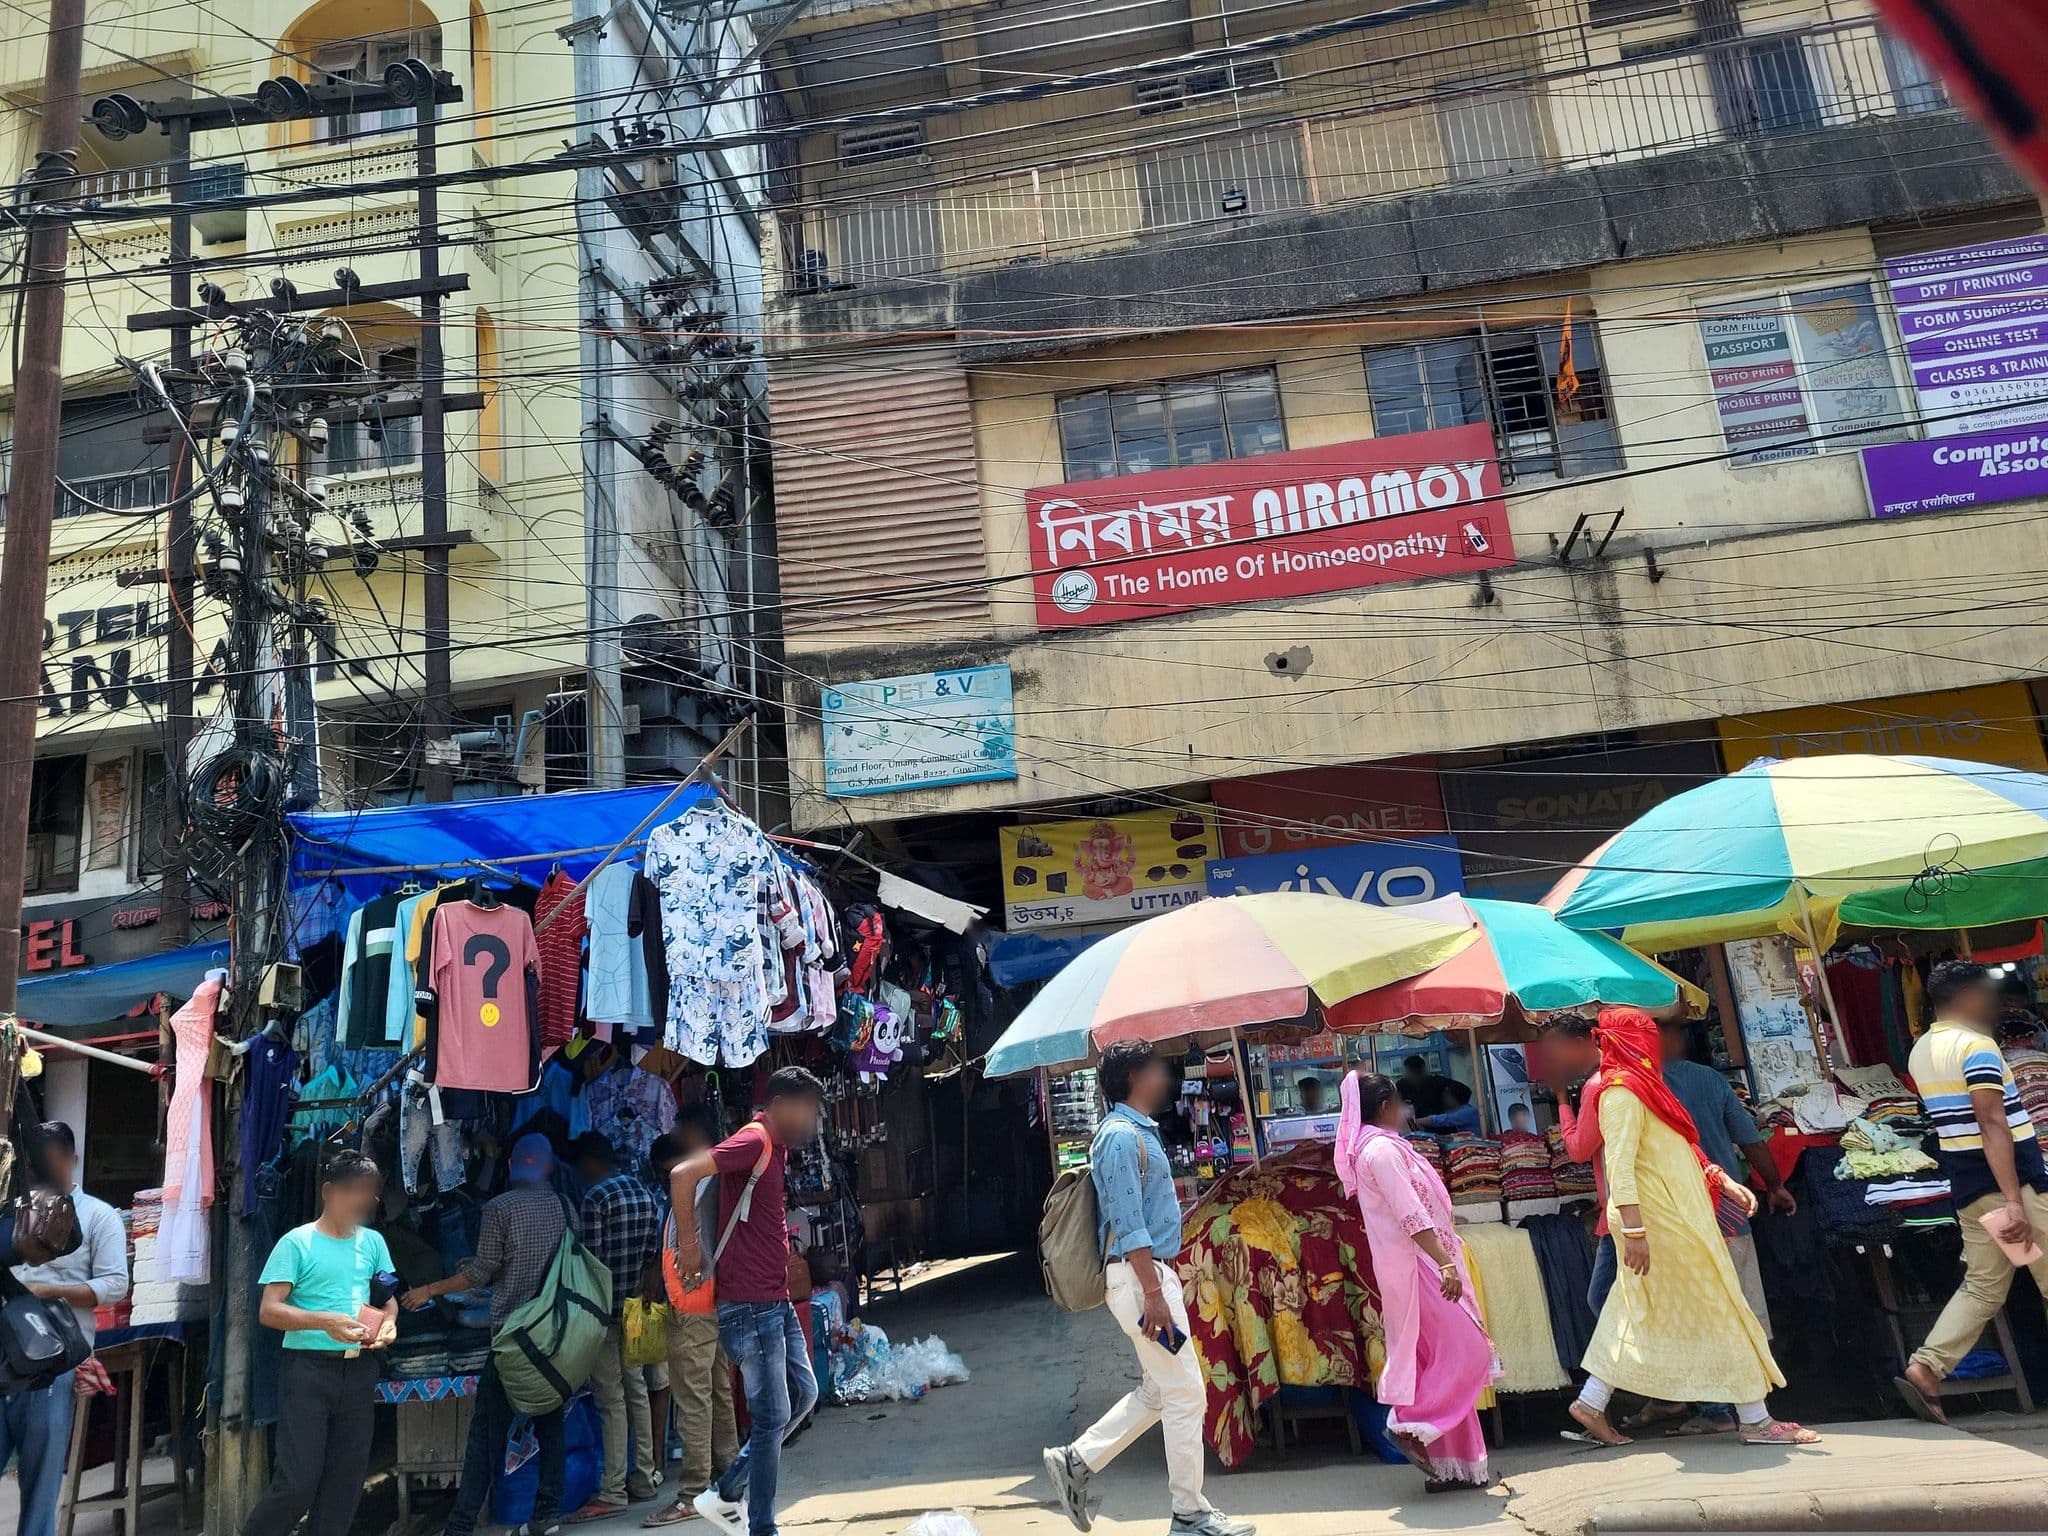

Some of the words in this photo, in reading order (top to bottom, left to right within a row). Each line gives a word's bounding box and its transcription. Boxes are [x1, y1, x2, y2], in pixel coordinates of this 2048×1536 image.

[1919, 284, 1948, 298] DTP
[1962, 271, 2033, 292] PRINTING
[1914, 311, 1960, 328] FORM
[1963, 297, 2048, 321] SUBMISSIO
[1707, 324, 1737, 333] FORM
[1742, 321, 1775, 331] FILLUP
[1712, 337, 1776, 356] PASSPORT
[1944, 333, 2001, 352] ONLINE
[2004, 328, 2039, 342] TEST
[1717, 371, 1748, 383] PHTO
[1752, 366, 1785, 381] PRINT
[1929, 365, 1986, 384] CLASSES
[1989, 363, 2000, 375] &
[1719, 396, 1761, 411] MOBILE
[1764, 391, 1798, 404] PRINT
[1728, 419, 1800, 438] SCANNING
[1252, 459, 1487, 537] NIRAMOY
[1103, 573, 1150, 598] The
[1157, 564, 1229, 591] Home
[1235, 552, 1265, 580] Of
[1271, 531, 1448, 575] Homoeopathy
[935, 678, 951, 697] &
[827, 763, 858, 776] Ground
[1495, 781, 1665, 827] SONATA
[1283, 804, 1425, 843] GIONEE
[1130, 889, 1200, 911] UTTAM
